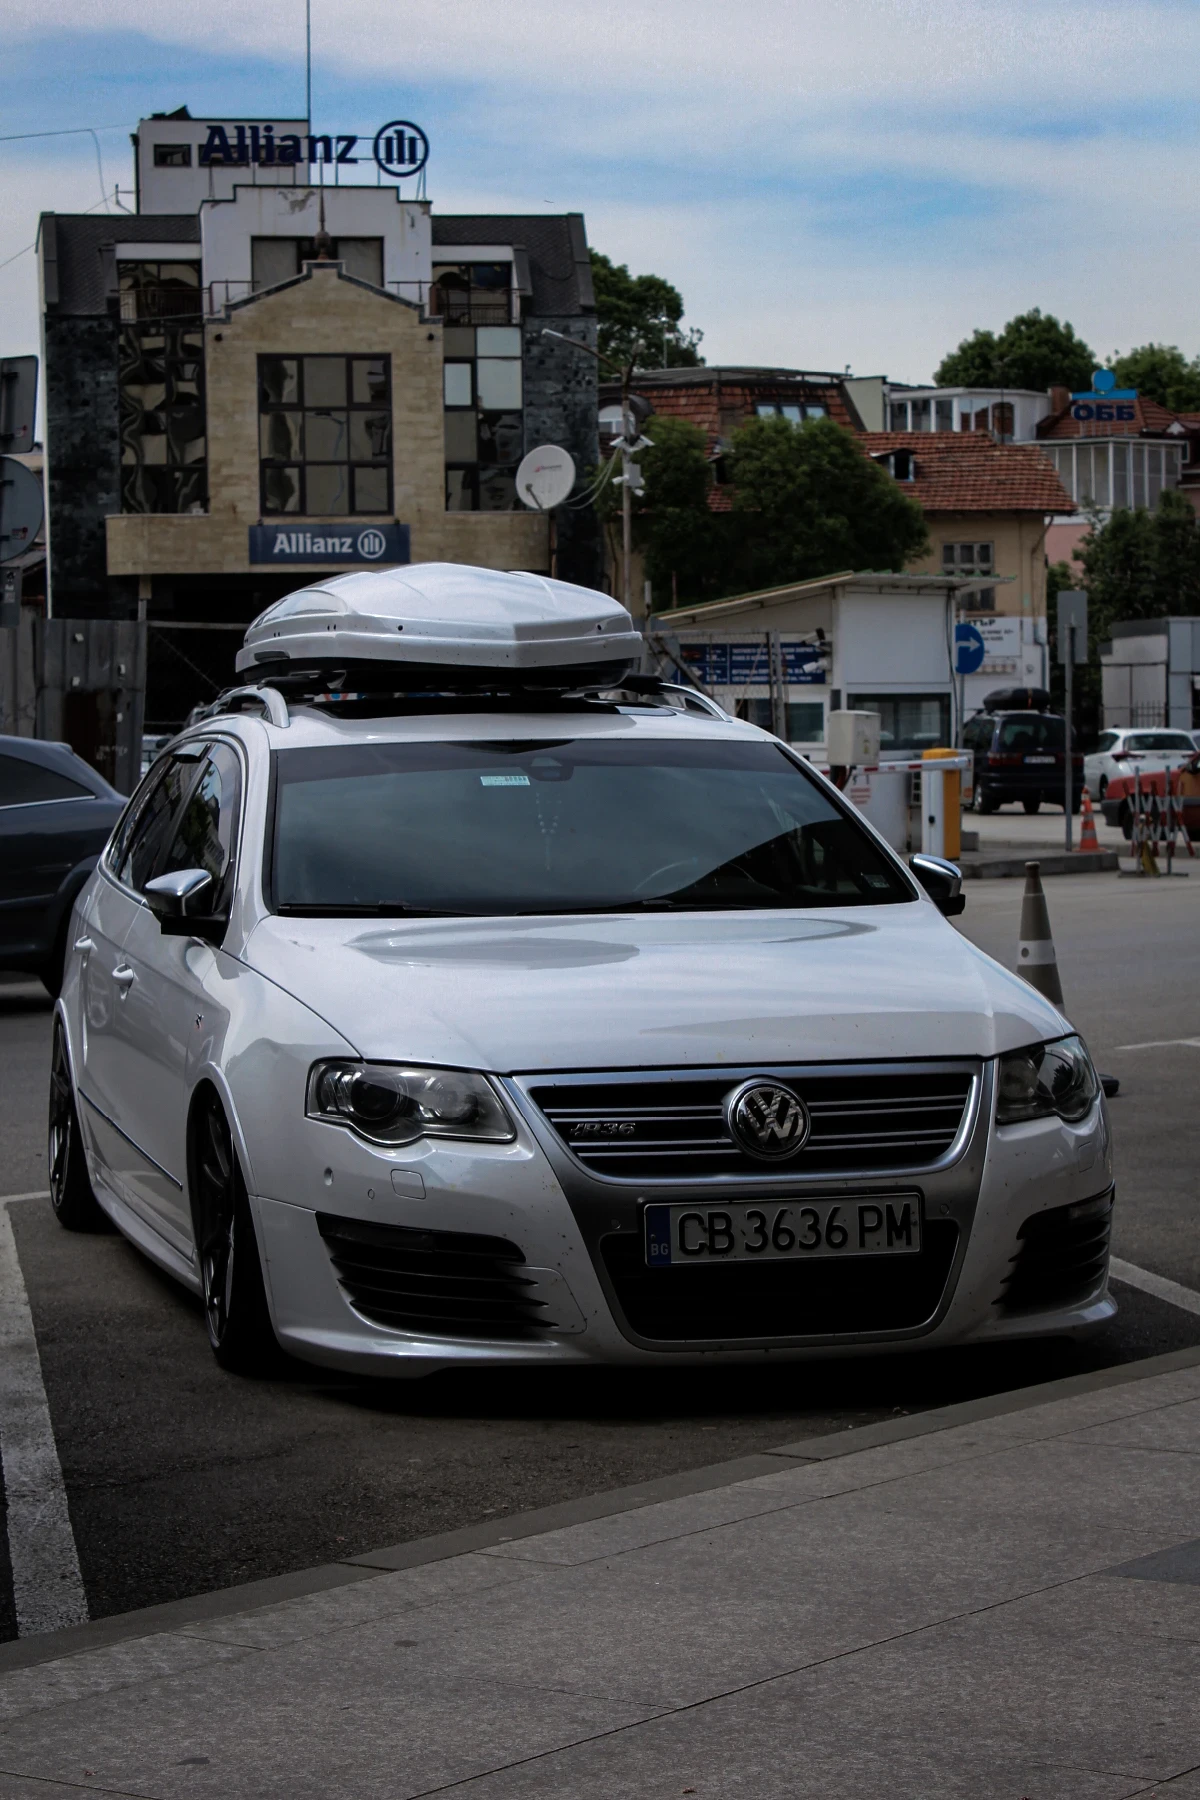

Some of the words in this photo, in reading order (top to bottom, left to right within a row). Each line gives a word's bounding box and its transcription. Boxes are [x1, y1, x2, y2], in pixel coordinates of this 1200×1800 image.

[201, 125, 358, 164] Allianz
[1072, 404, 1136, 421] ОББ
[272, 532, 354, 554] Allianz
[678, 1211, 735, 1256] CB
[744, 1206, 849, 1253] 3636
[857, 1203, 913, 1248] PM
[650, 1242, 669, 1256] BG
